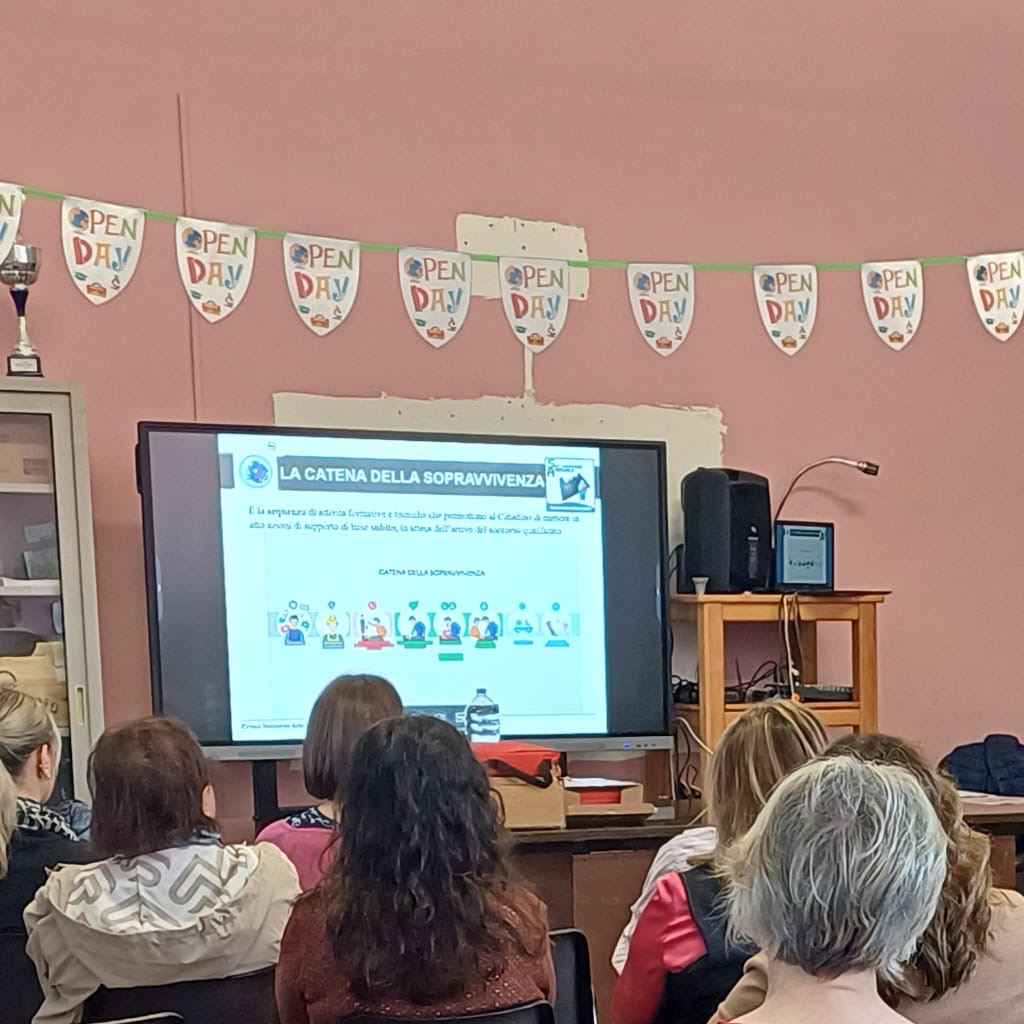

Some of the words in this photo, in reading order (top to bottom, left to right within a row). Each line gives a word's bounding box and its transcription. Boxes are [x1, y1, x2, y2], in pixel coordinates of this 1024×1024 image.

[72, 236, 132, 272] DAY
[186, 256, 243, 290] DAY
[294, 271, 350, 302] DAY
[410, 285, 463, 314] DAY
[511, 292, 561, 320] DAY
[639, 298, 687, 324] DAY
[766, 298, 811, 324] DAY
[873, 293, 917, 320] DAY
[979, 285, 1020, 312] DAY
[279, 466, 301, 481] LA
[304, 467, 367, 483] CATENA
[370, 469, 421, 484] DELLA
[423, 471, 545, 488] SOPRAVVIVENZA
